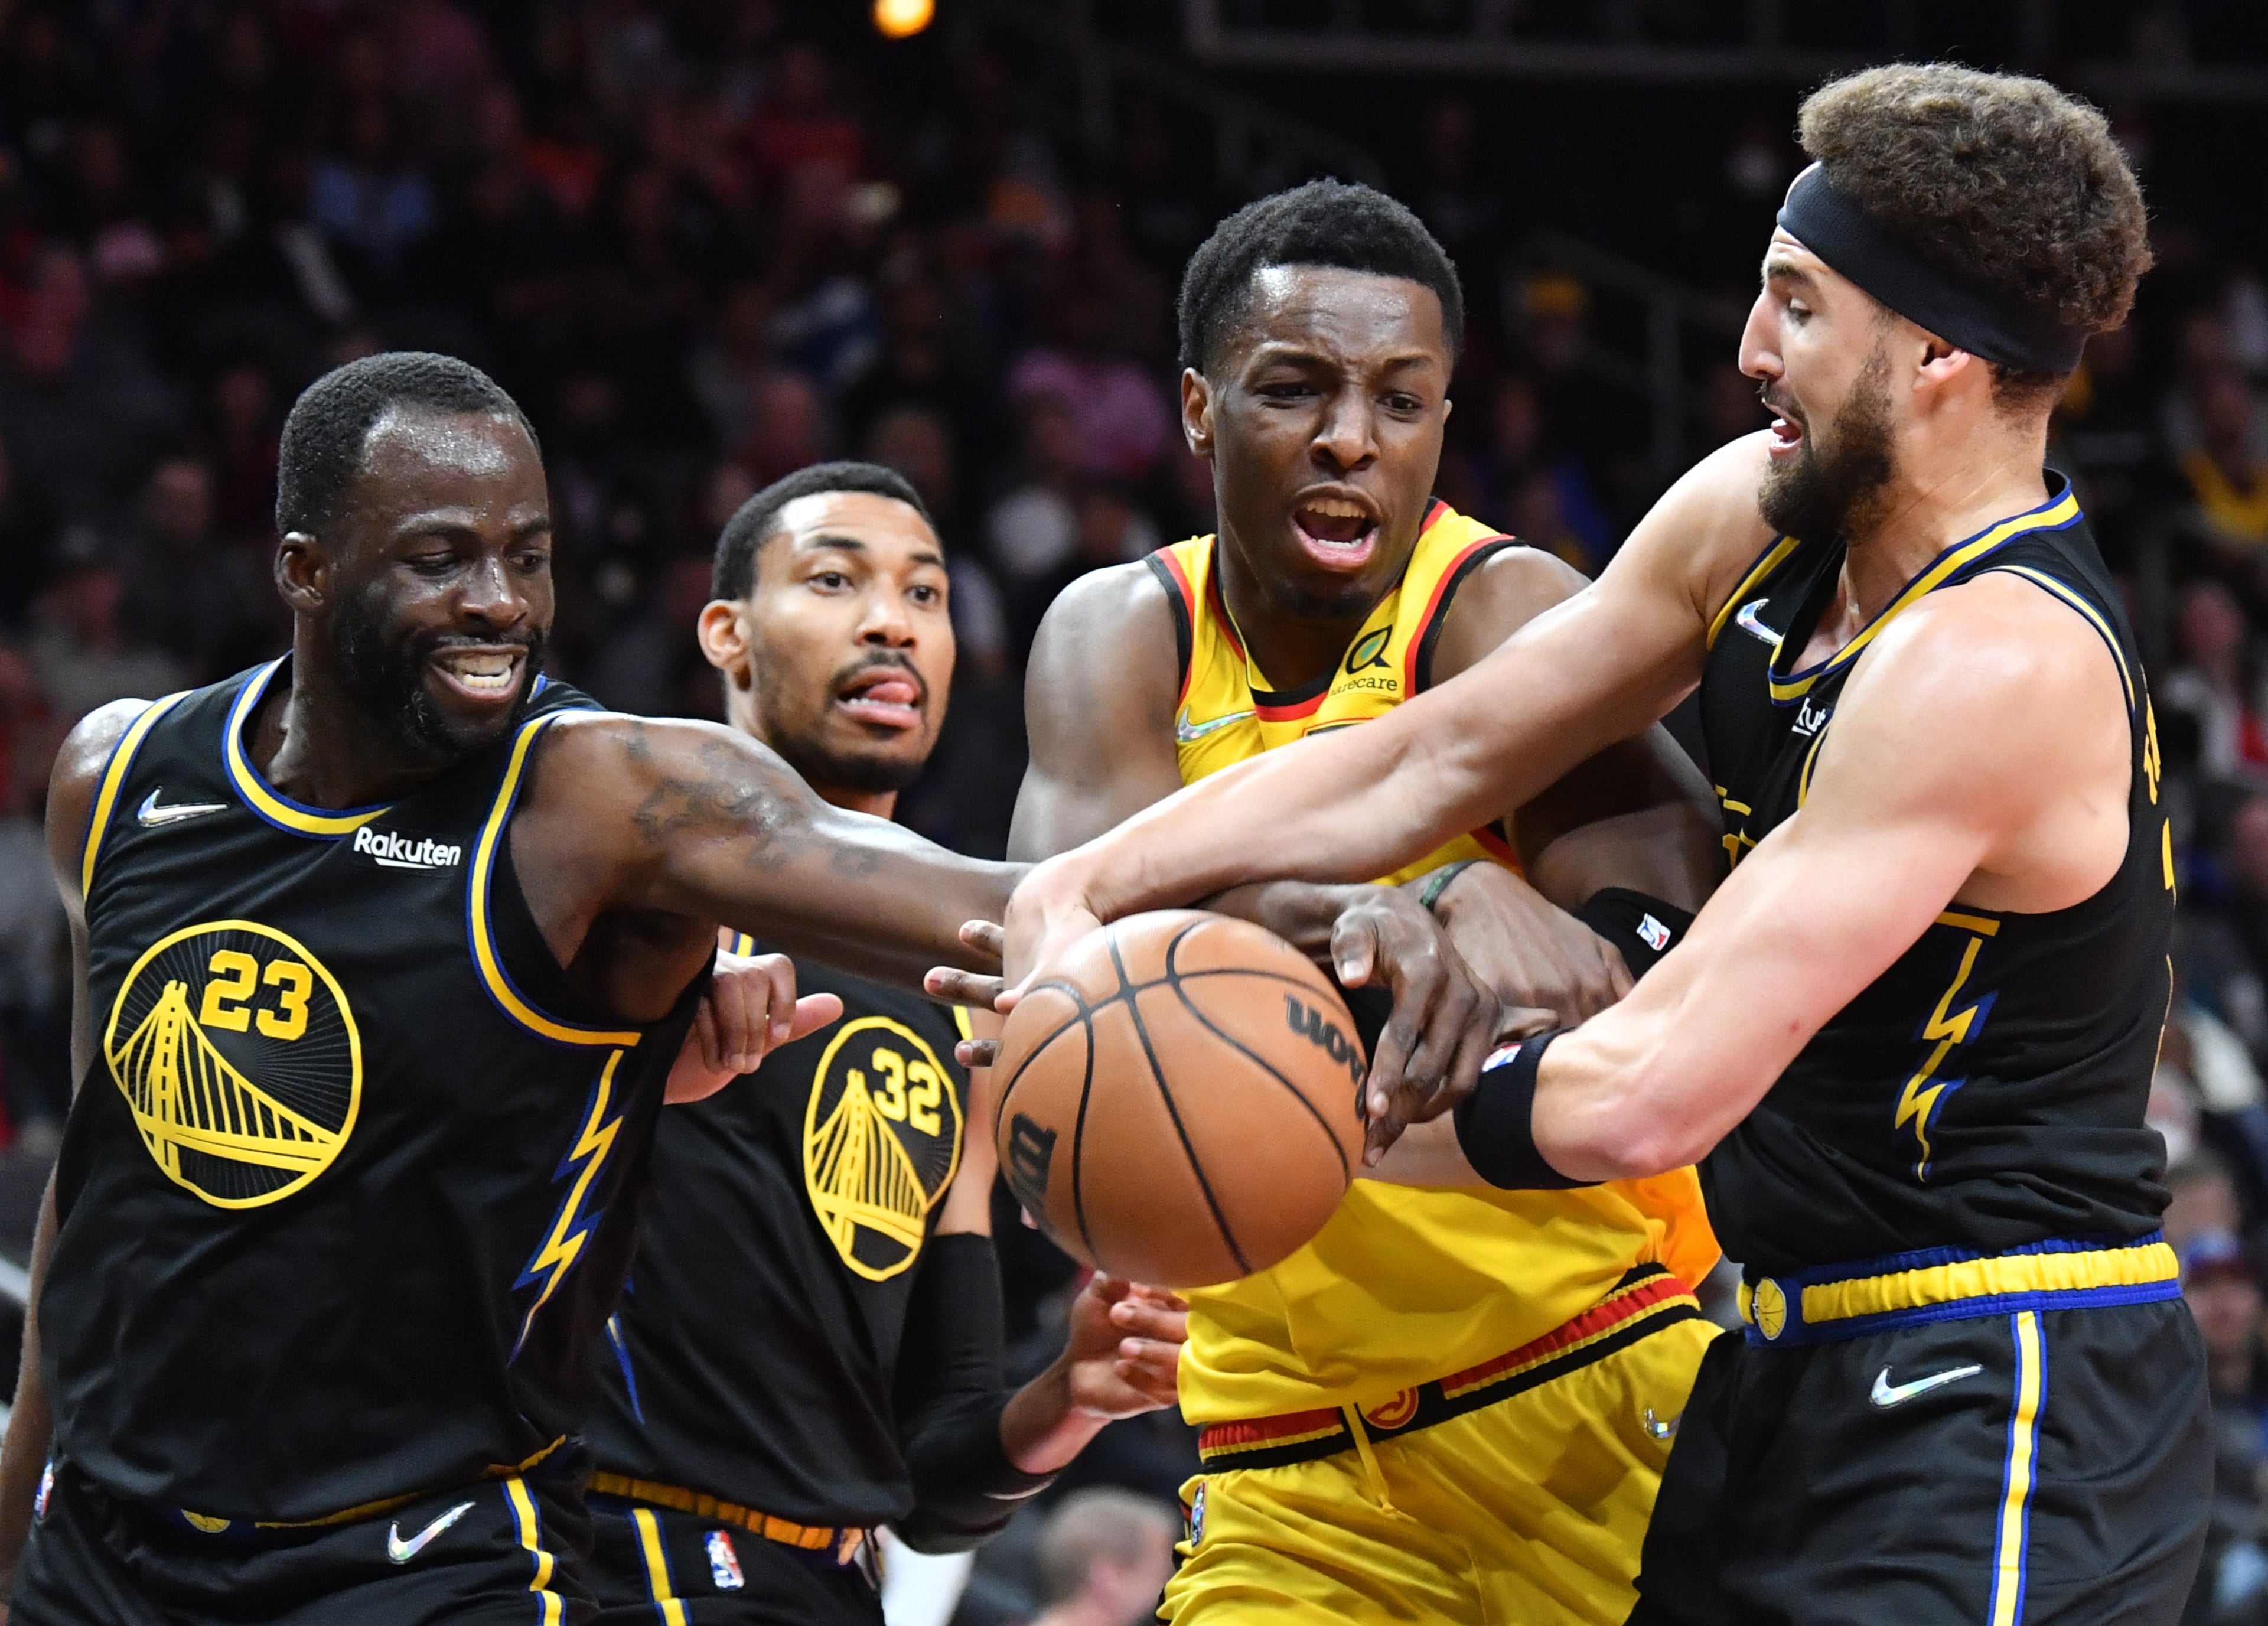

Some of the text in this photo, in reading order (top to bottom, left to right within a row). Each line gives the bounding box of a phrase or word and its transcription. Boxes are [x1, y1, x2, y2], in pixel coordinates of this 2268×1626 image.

[354, 827, 461, 866] Rakuten
[200, 949, 312, 1040] 23
[872, 1048, 941, 1136] 32
